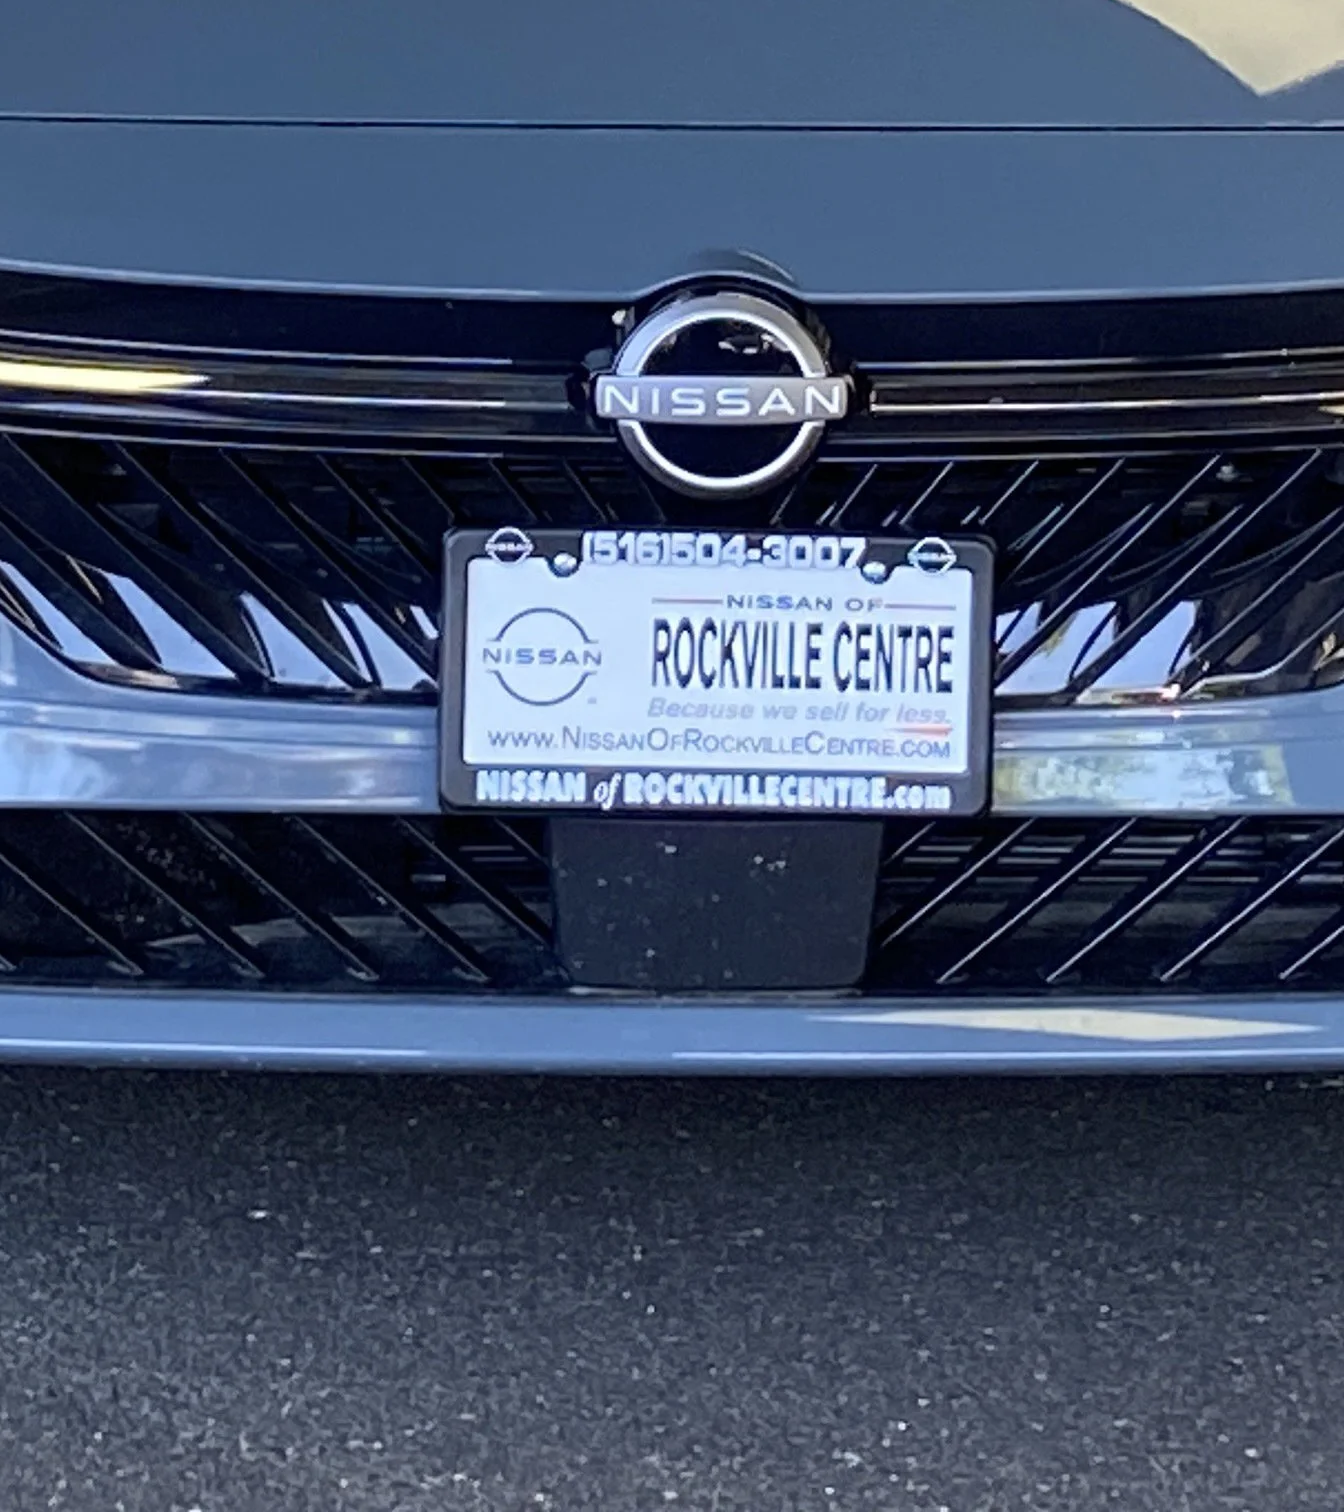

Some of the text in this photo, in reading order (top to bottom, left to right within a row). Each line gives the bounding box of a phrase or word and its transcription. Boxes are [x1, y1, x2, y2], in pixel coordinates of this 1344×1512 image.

[602, 385, 840, 416] NISSAN
[582, 530, 867, 569] (516)504-3007
[727, 594, 884, 613] NISSAN OF
[482, 647, 602, 667] NISSAN
[652, 617, 954, 693] ROCKVILLE CENTRE
[647, 697, 952, 724] Because we sell for less.
[476, 769, 952, 810] NISSAN of ROCKVILLECENTRE.com
